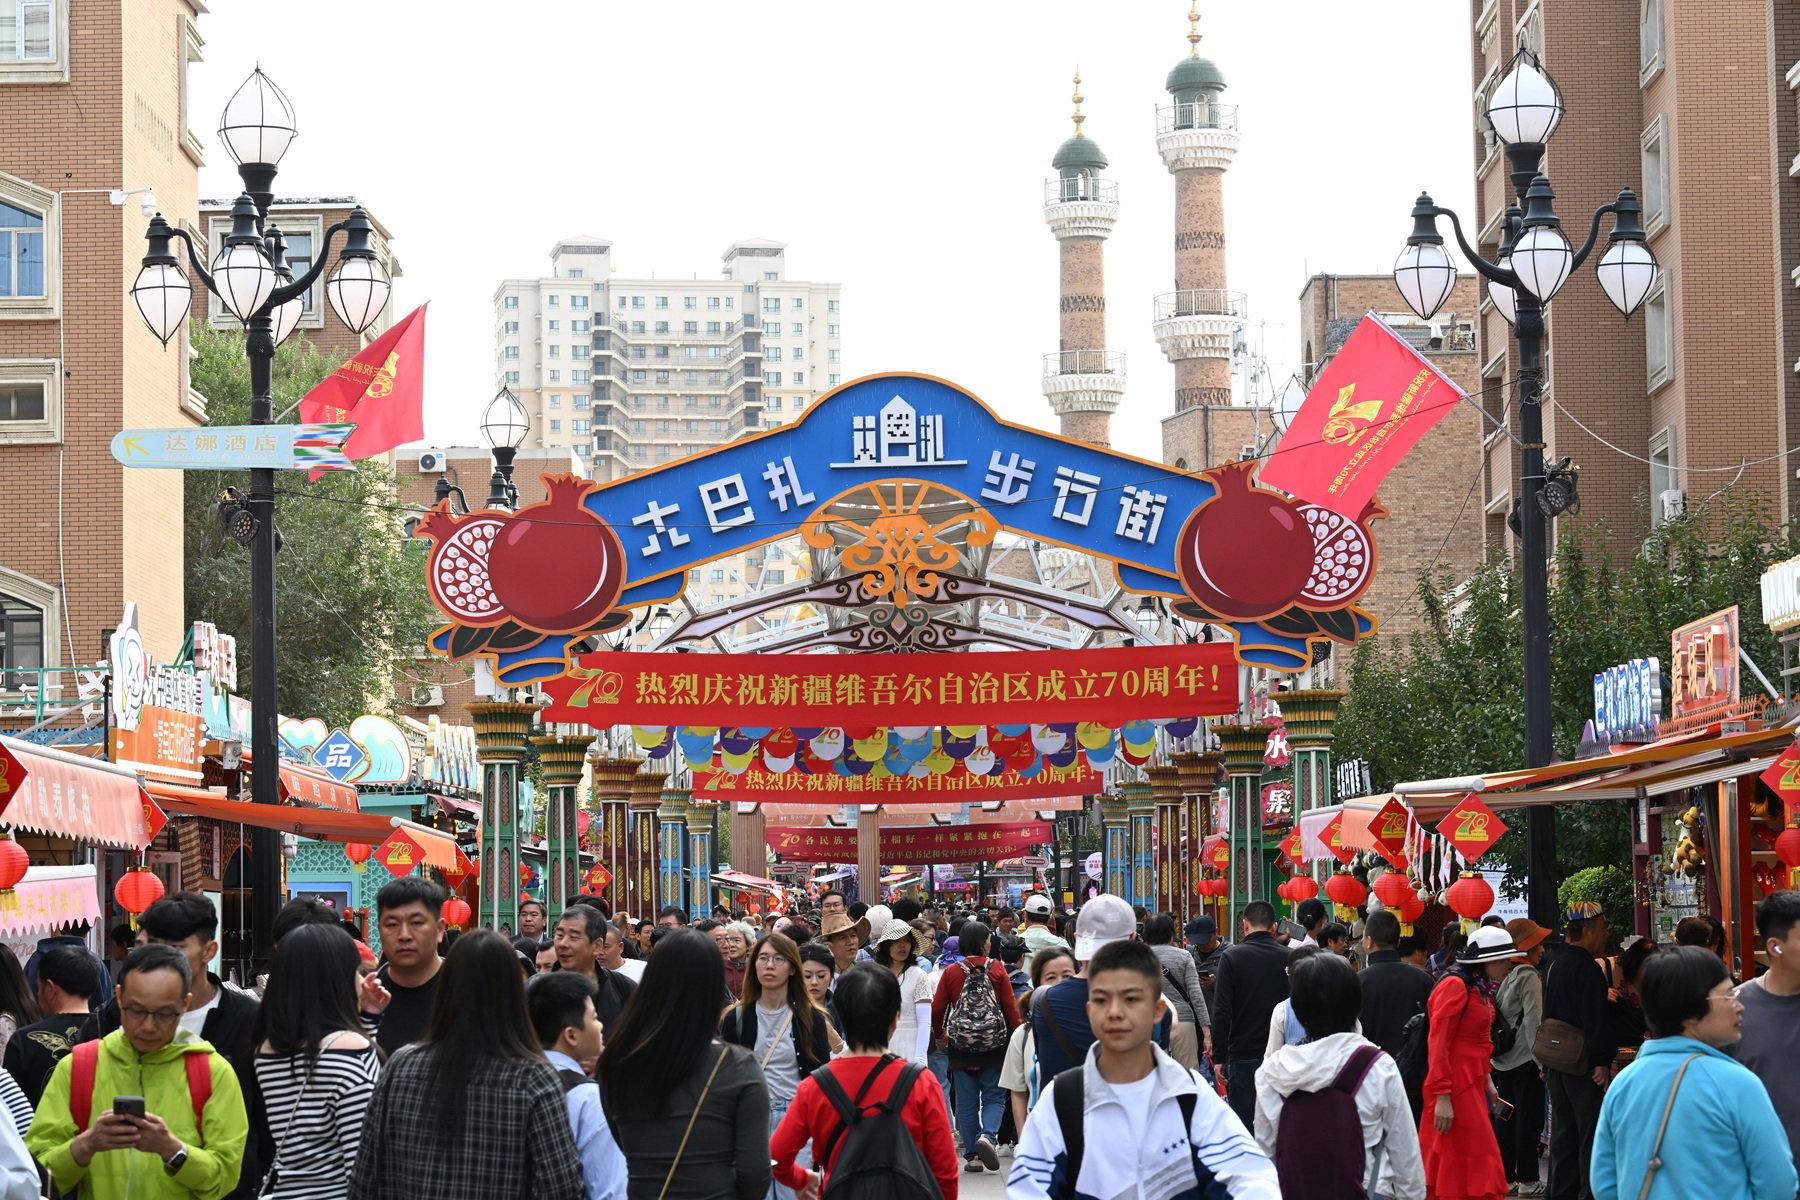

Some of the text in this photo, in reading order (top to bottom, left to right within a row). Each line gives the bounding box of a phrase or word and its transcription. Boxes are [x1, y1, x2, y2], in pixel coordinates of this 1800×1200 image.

[165, 434, 278, 451] 达娜酒店
[632, 450, 1168, 557] 大巴扎 步行街
[636, 663, 1220, 706] 热烈庆祝新疆维吾尔自治区成立70周年！
[325, 743, 353, 768] 品
[1264, 734, 1290, 759] 水
[806, 827, 1040, 847] 各民族要石榴籽一样紧紧抱在一起！
